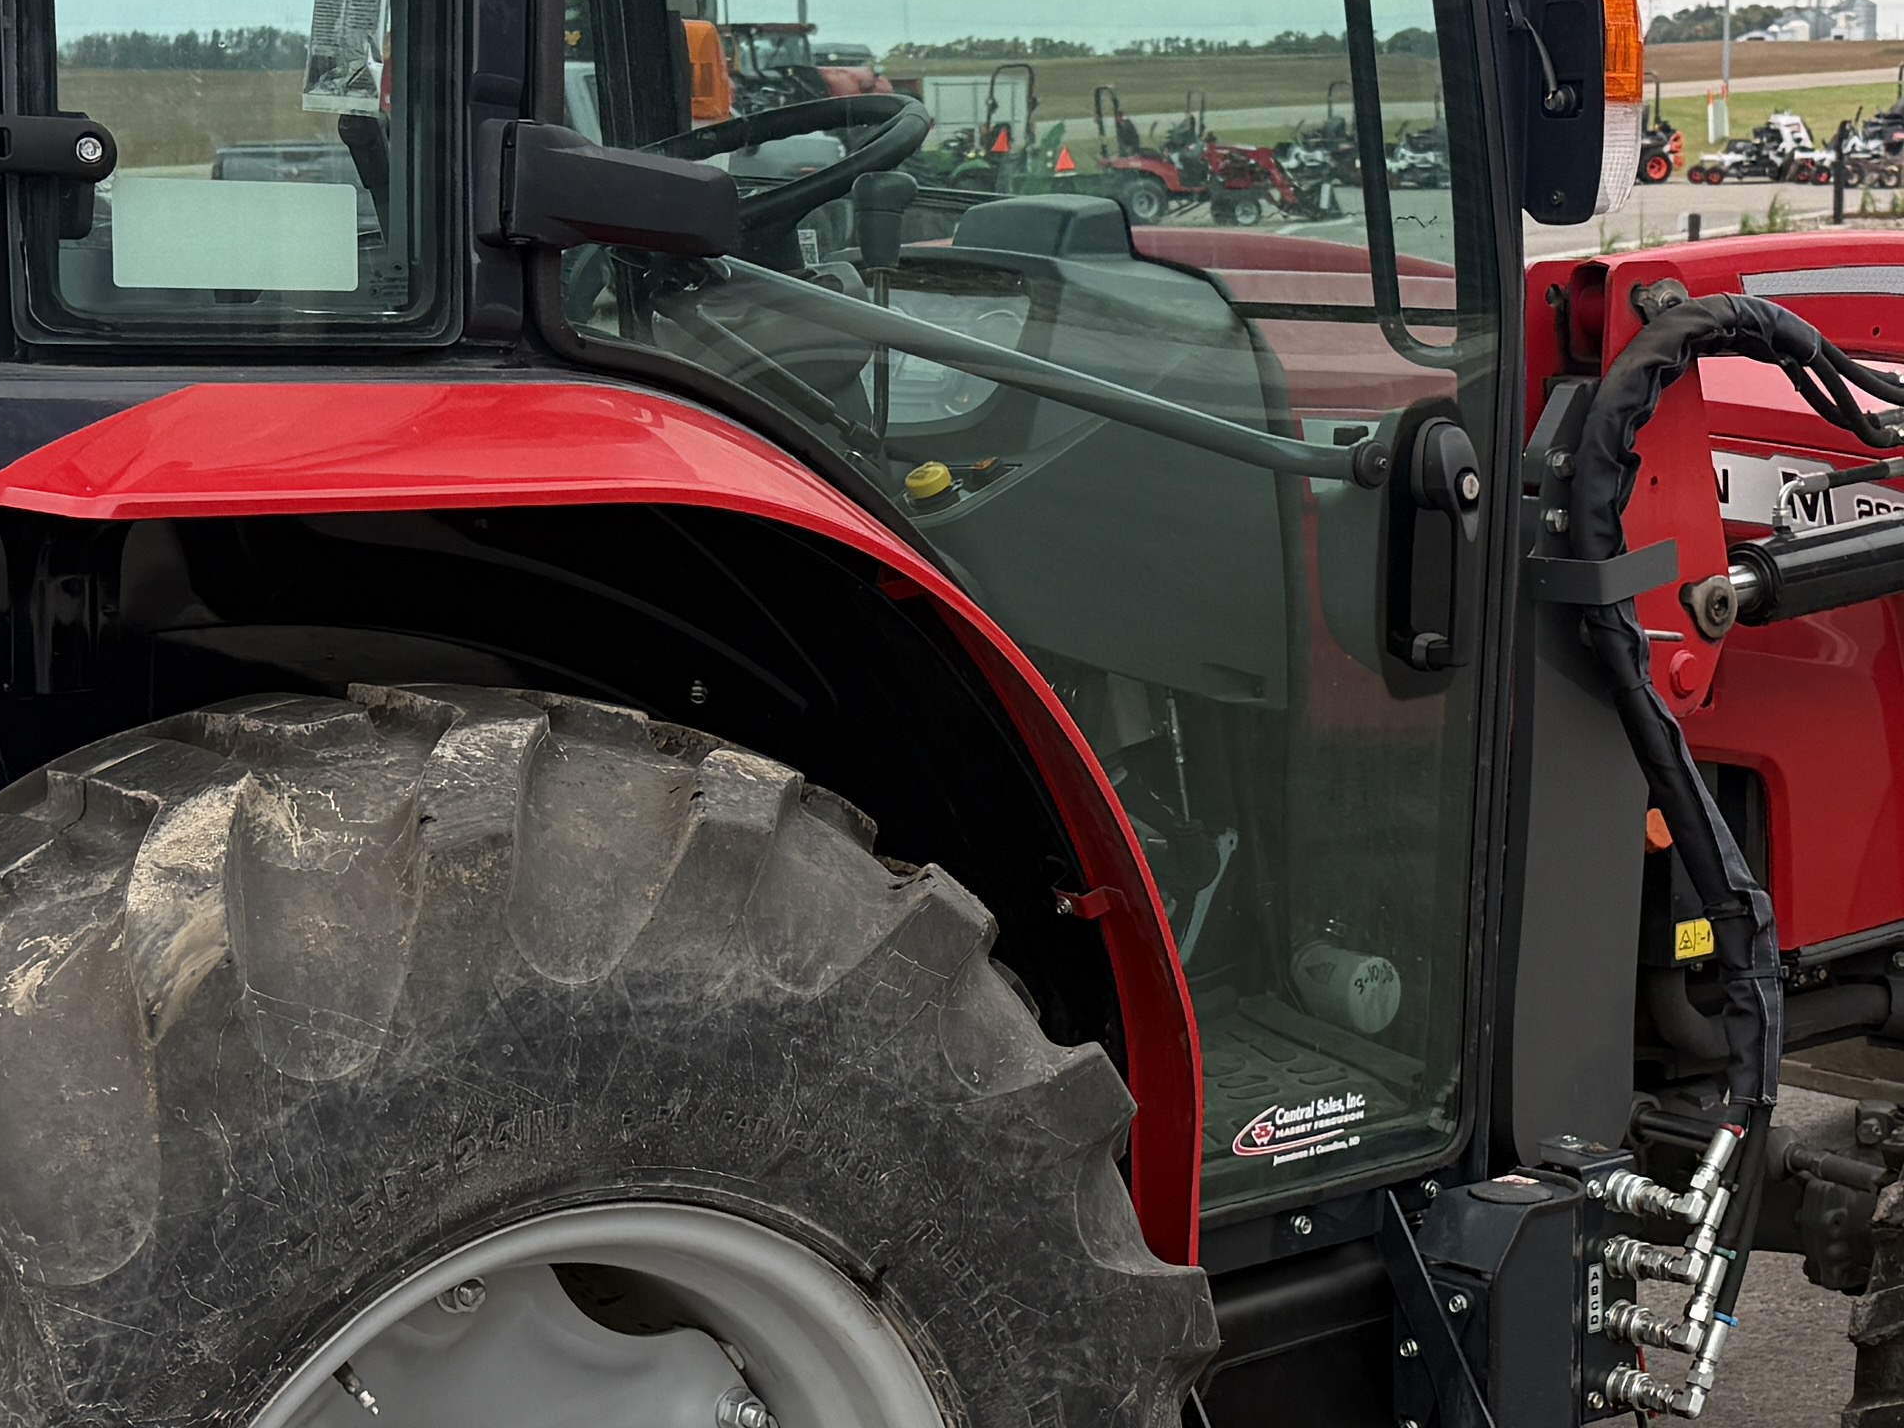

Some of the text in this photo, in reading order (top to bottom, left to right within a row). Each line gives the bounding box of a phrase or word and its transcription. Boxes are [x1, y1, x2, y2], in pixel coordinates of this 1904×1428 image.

[1275, 1092, 1366, 1124] Central Sales, Inc.
[1275, 1110, 1365, 1139] MASSEY FERGUSON
